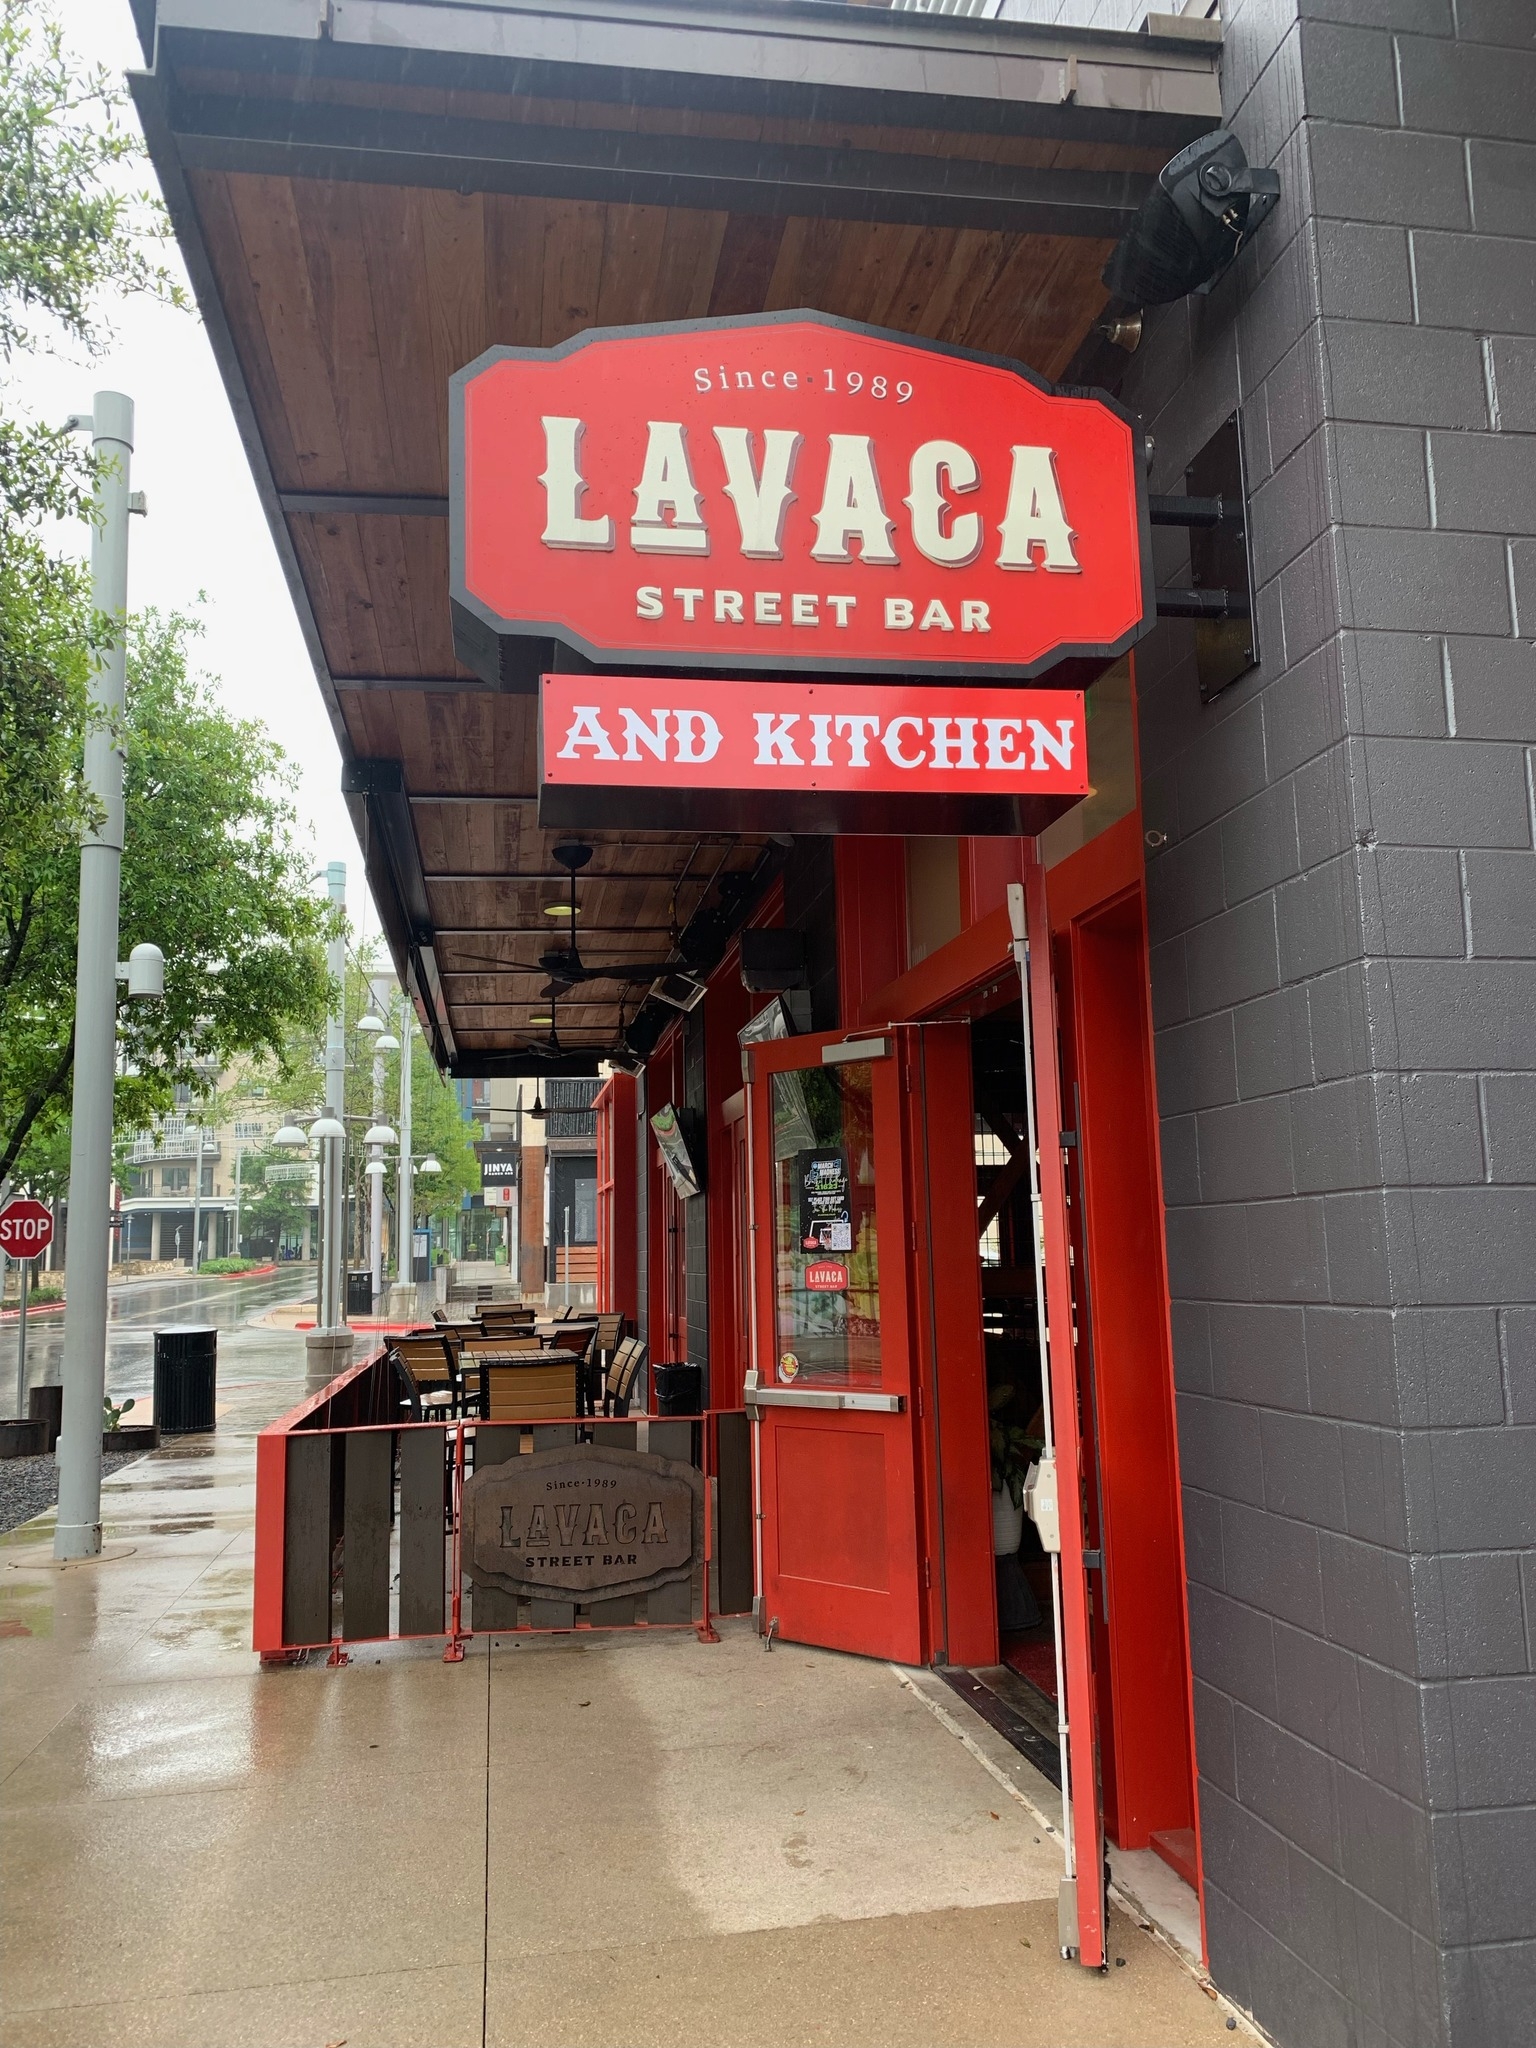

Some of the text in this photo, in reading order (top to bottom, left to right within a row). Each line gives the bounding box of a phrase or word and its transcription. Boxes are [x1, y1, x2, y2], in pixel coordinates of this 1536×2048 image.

[693, 365, 913, 404] Since 1989
[537, 416, 1082, 574] LAVACA
[635, 586, 991, 633] STREET BAR
[556, 705, 1075, 772] AND KITCHEN
[484, 1163, 514, 1175] JINYA
[0, 1218, 50, 1240] STOP
[809, 1271, 843, 1283] LAVACA
[499, 1501, 669, 1549] LAVACA
[525, 1554, 638, 1568] STREET BAR
